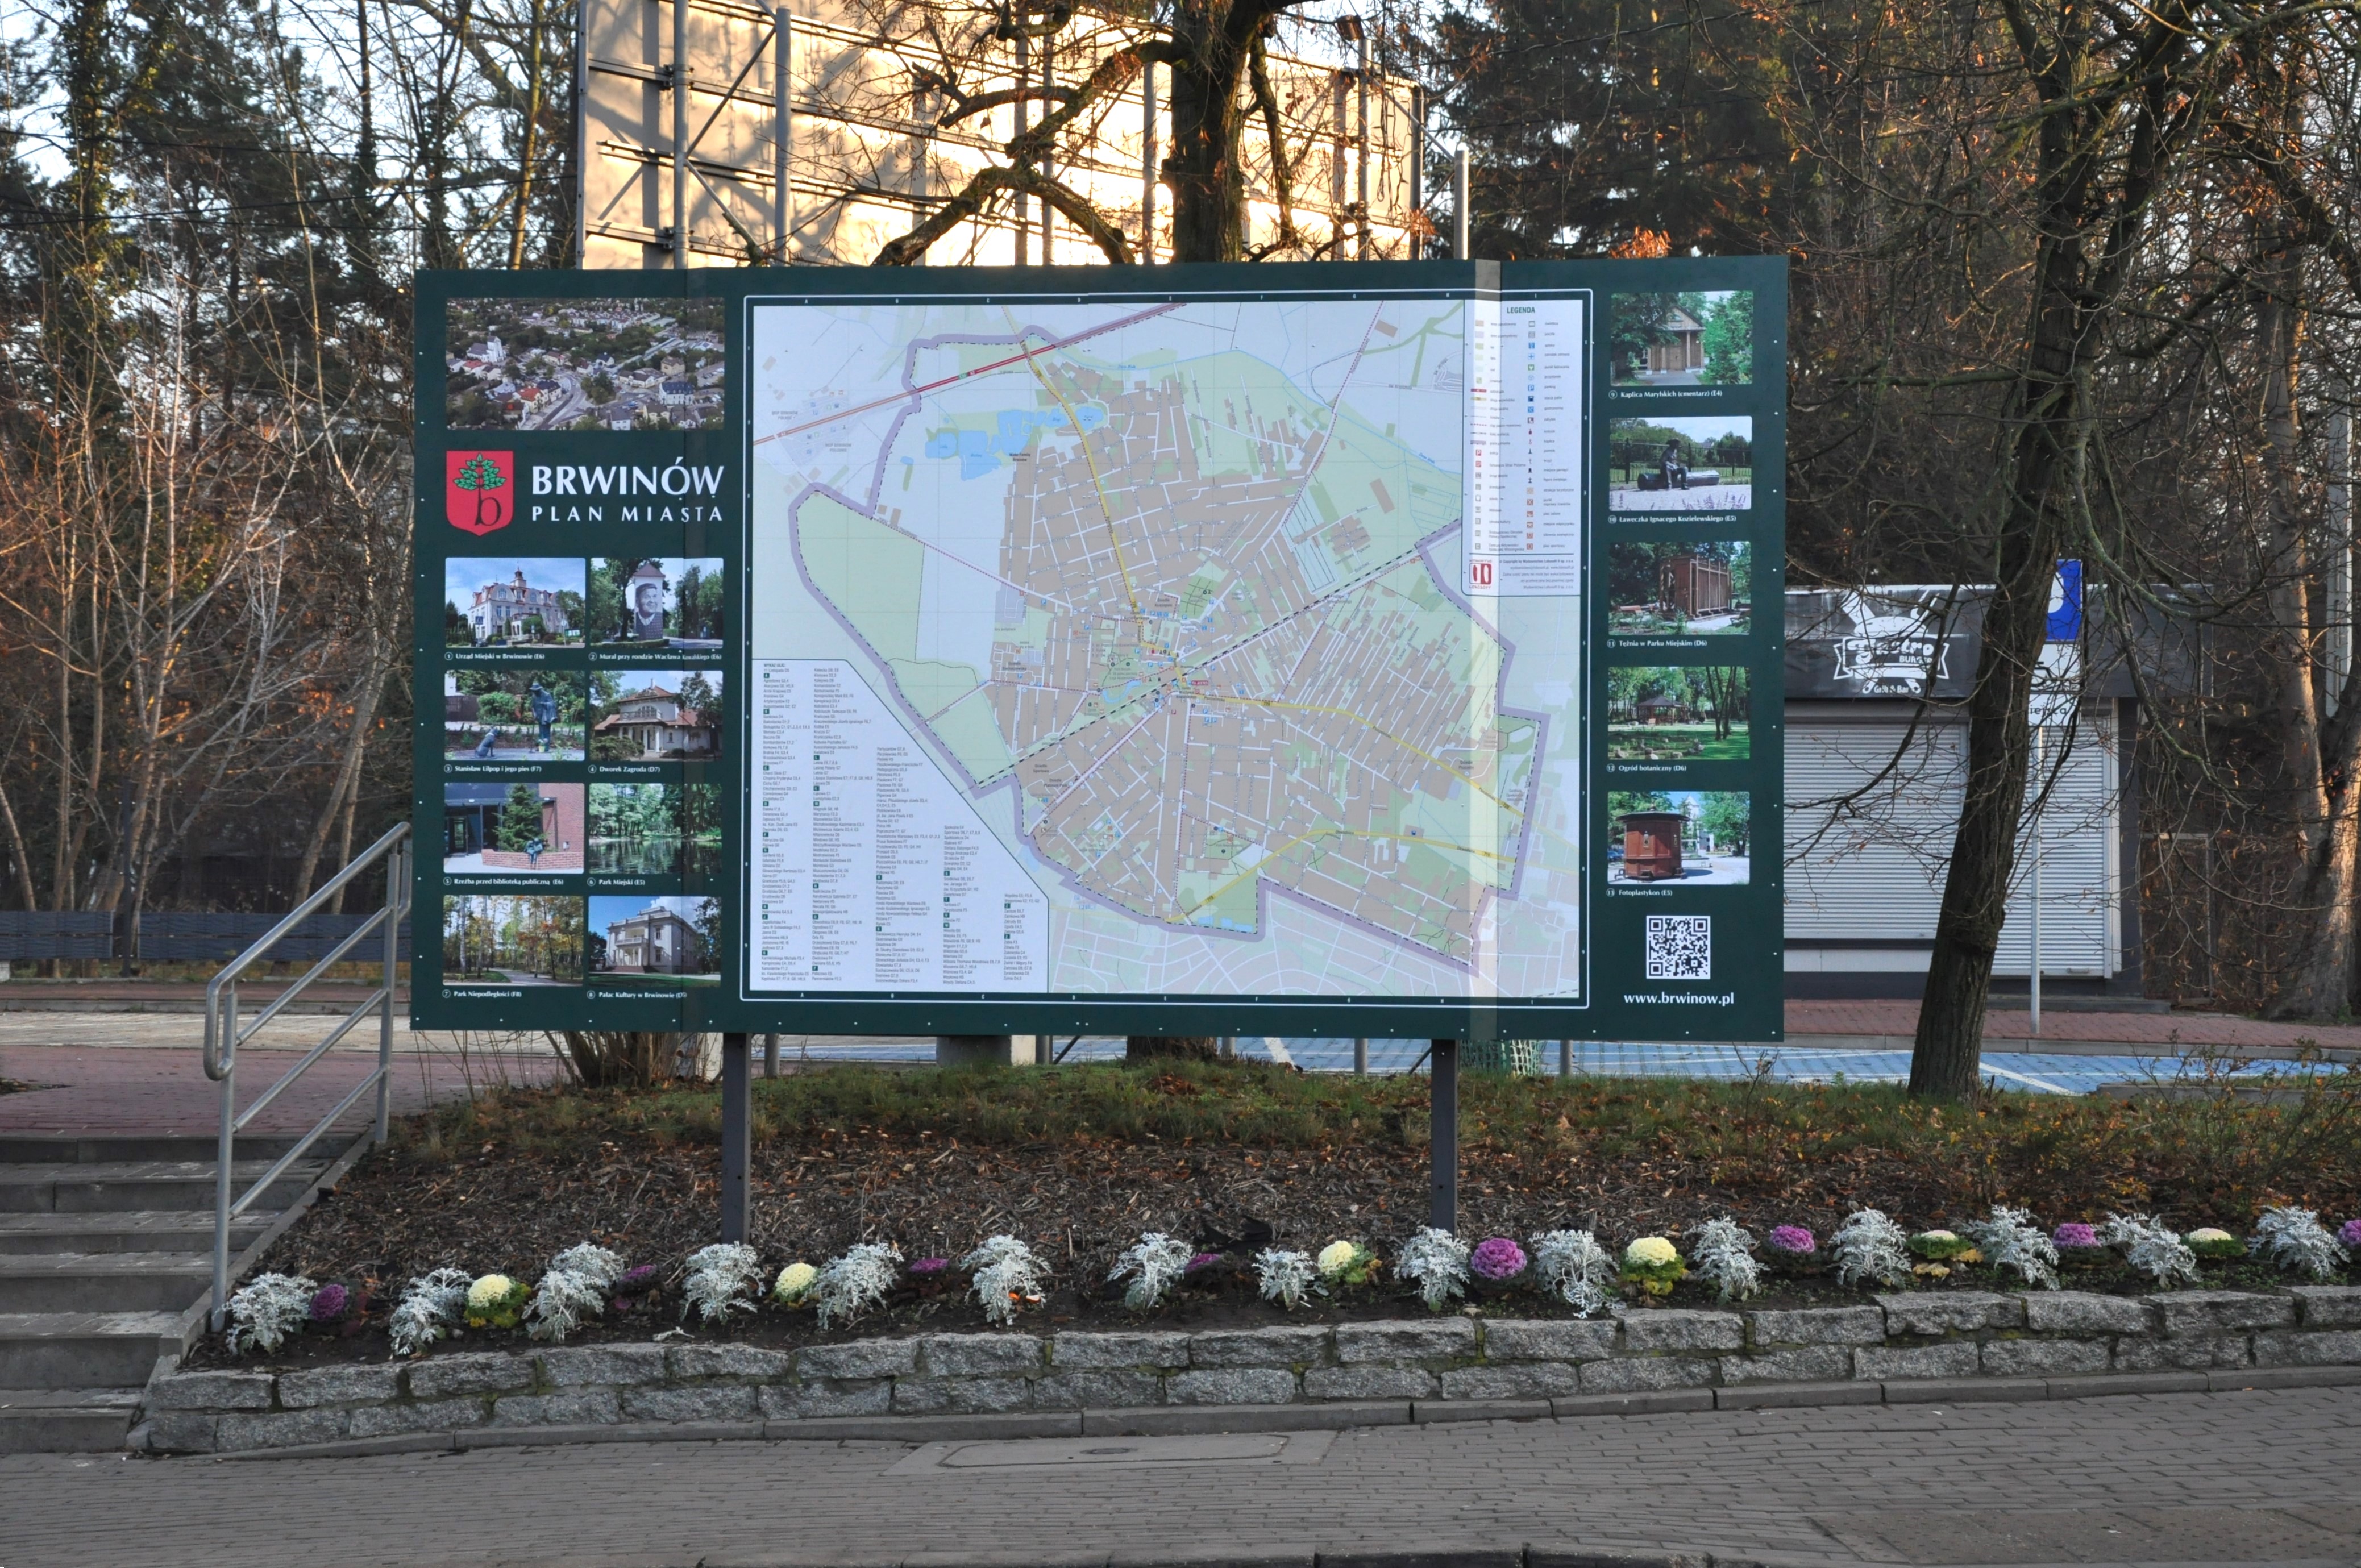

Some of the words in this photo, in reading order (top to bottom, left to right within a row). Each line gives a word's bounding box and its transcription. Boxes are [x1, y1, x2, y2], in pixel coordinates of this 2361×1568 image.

[532, 456, 724, 497] BRWINÓW
[532, 506, 602, 521] PLAN
[621, 506, 722, 522] MIASTA
[1897, 685, 1909, 693] Bar
[522, 878, 551, 887] publiczną
[1623, 991, 1734, 1007] www.brwinow.pl
